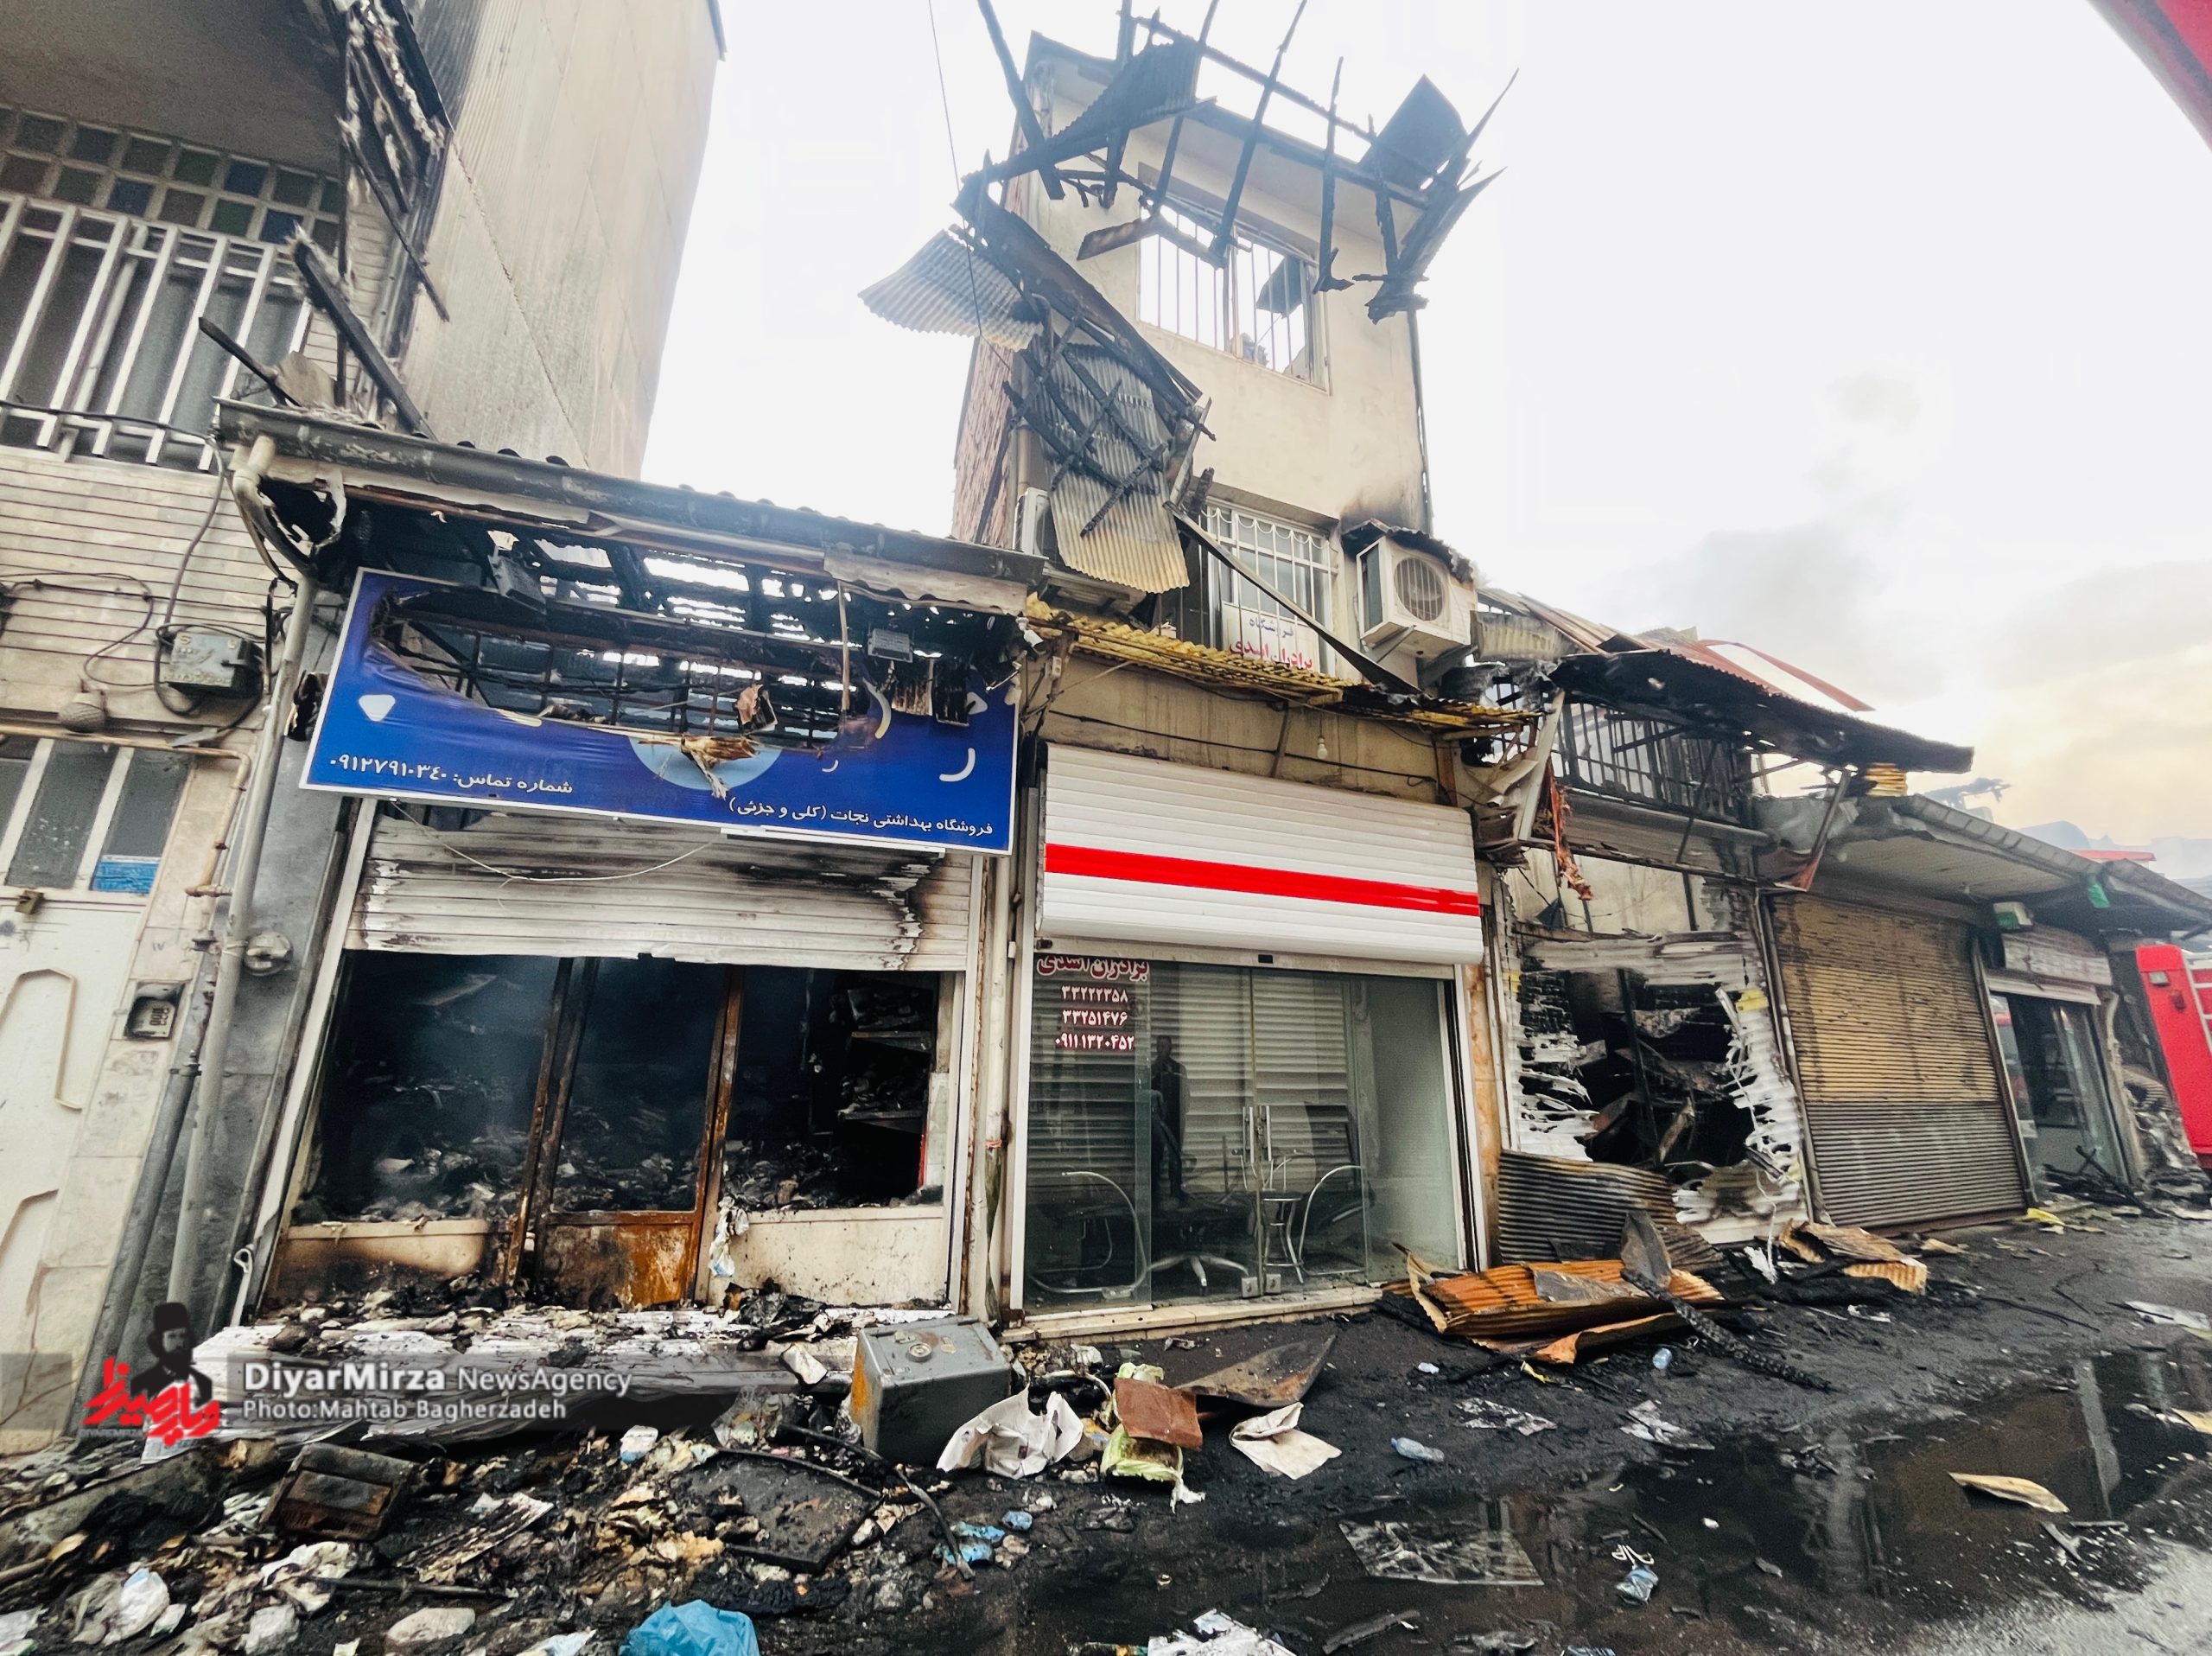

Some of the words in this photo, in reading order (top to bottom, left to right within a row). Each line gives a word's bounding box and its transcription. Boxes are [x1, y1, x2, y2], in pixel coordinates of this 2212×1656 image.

[1249, 617, 1294, 638] فرشگاه
[454, 774, 511, 789] تماس:
[517, 779, 573, 794] شماره
[779, 806, 788, 818] و
[791, 805, 827, 820] (کلی
[830, 809, 869, 823] نجات
[873, 814, 931, 830] بهداشتی
[936, 818, 993, 837] فروشگاه
[1037, 954, 1090, 976] اسدی
[1090, 959, 1148, 981] برادران
[1061, 985, 1128, 1003] ۳۳۲۲۲۳۵۸
[1063, 1010, 1128, 1026] ۳۳۲۵۱۴۷۶
